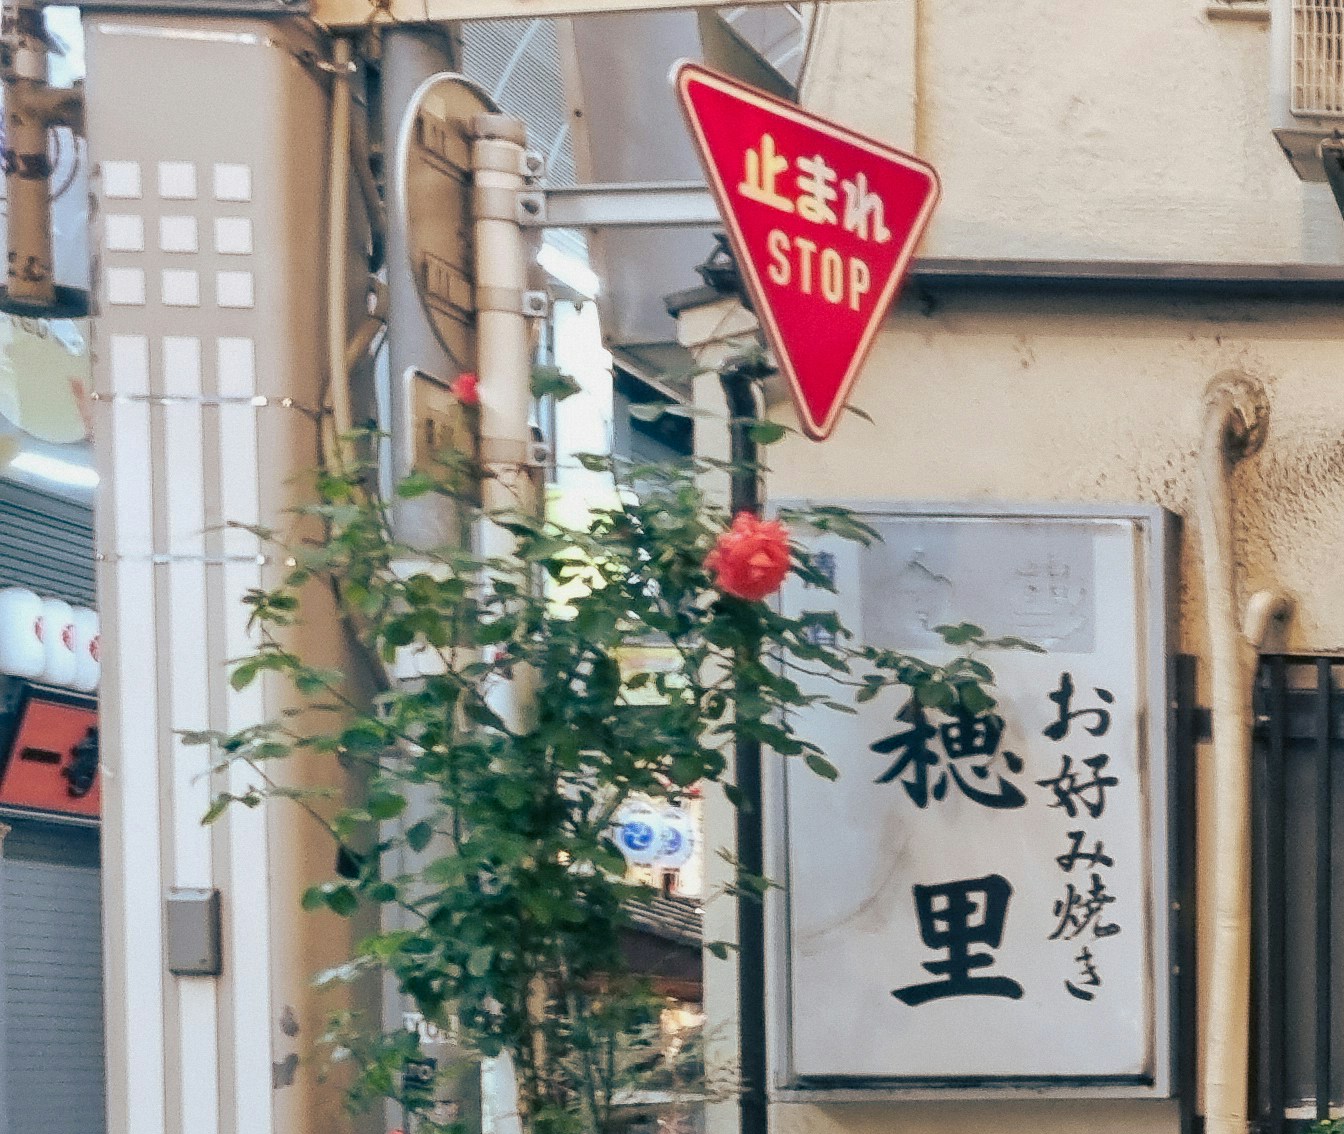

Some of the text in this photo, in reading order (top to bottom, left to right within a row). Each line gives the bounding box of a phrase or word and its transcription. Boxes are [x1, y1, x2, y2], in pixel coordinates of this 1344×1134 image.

[737, 132, 893, 245] 止まれ
[767, 227, 872, 312] STOP
[869, 684, 1029, 1008] 穂里
[1036, 671, 1121, 1002] お好み焼き
